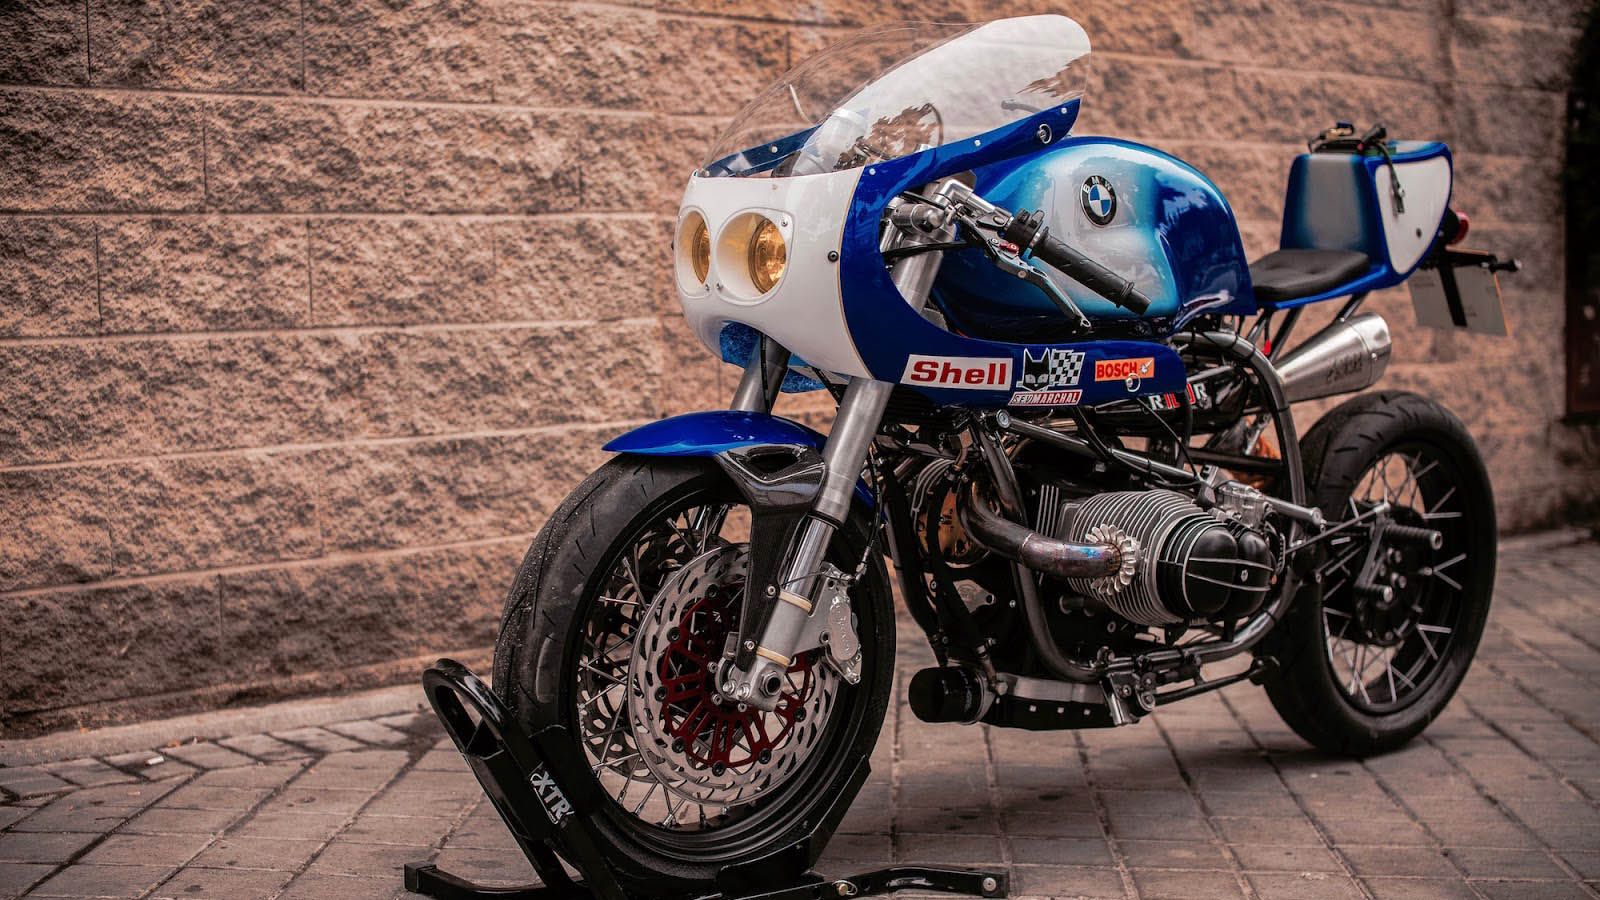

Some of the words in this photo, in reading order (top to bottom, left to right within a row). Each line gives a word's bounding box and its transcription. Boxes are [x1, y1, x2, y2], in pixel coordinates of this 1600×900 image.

[1082, 176, 1112, 194] BMW
[910, 360, 1007, 387] Shell
[1096, 361, 1138, 378] BOSCH
[531, 771, 571, 820] XTR
